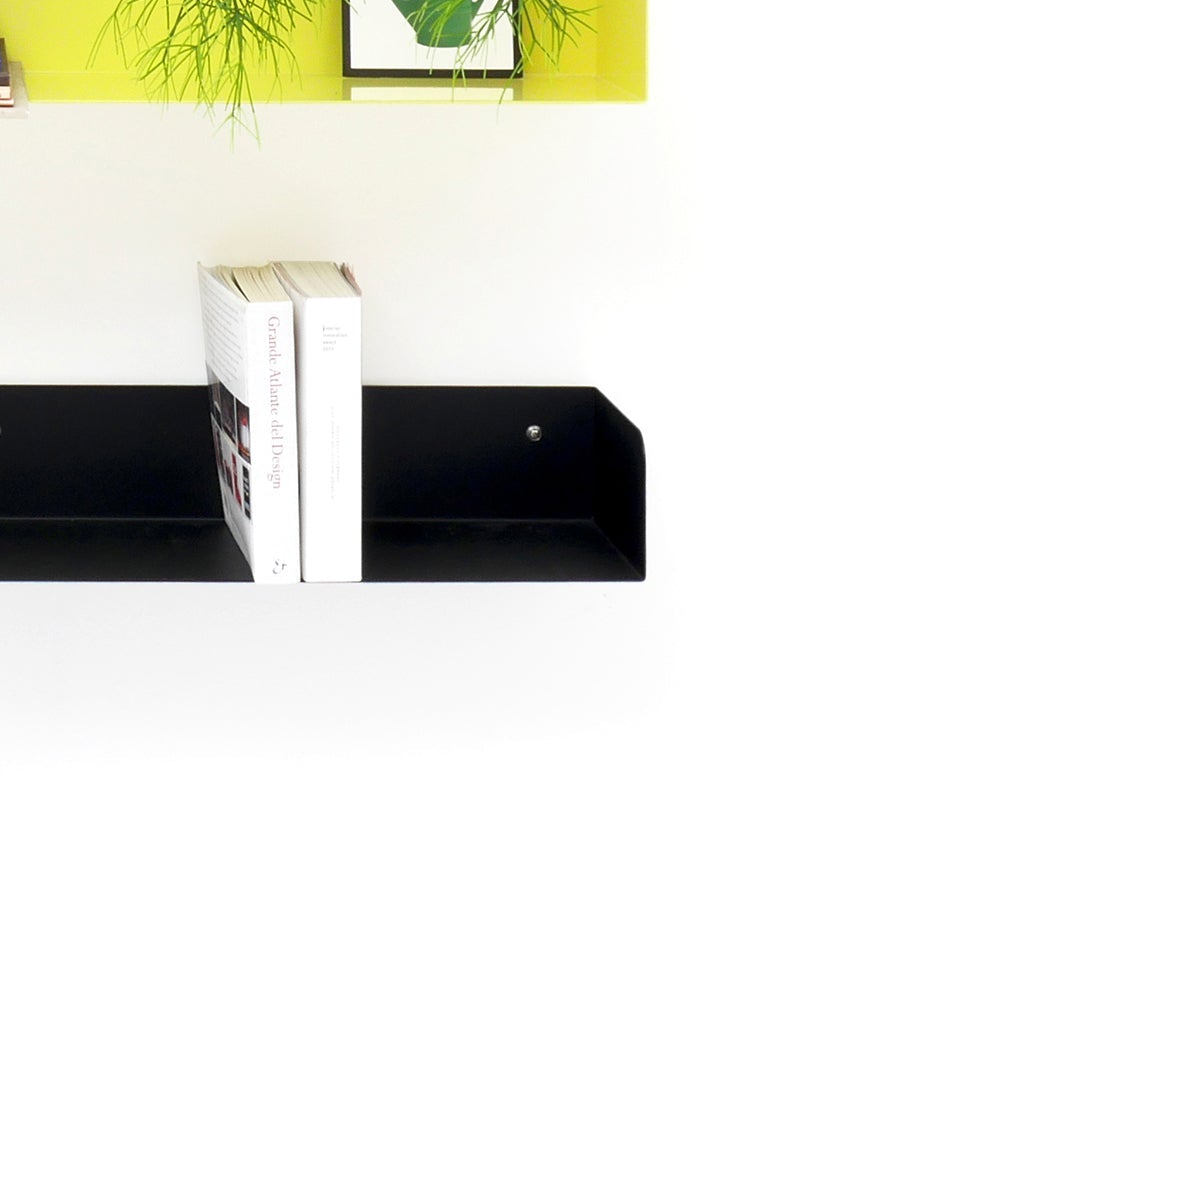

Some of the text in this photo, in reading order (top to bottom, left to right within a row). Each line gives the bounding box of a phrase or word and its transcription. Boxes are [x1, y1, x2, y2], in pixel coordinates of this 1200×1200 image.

[267, 315, 285, 489] Grande Atlante del Design
